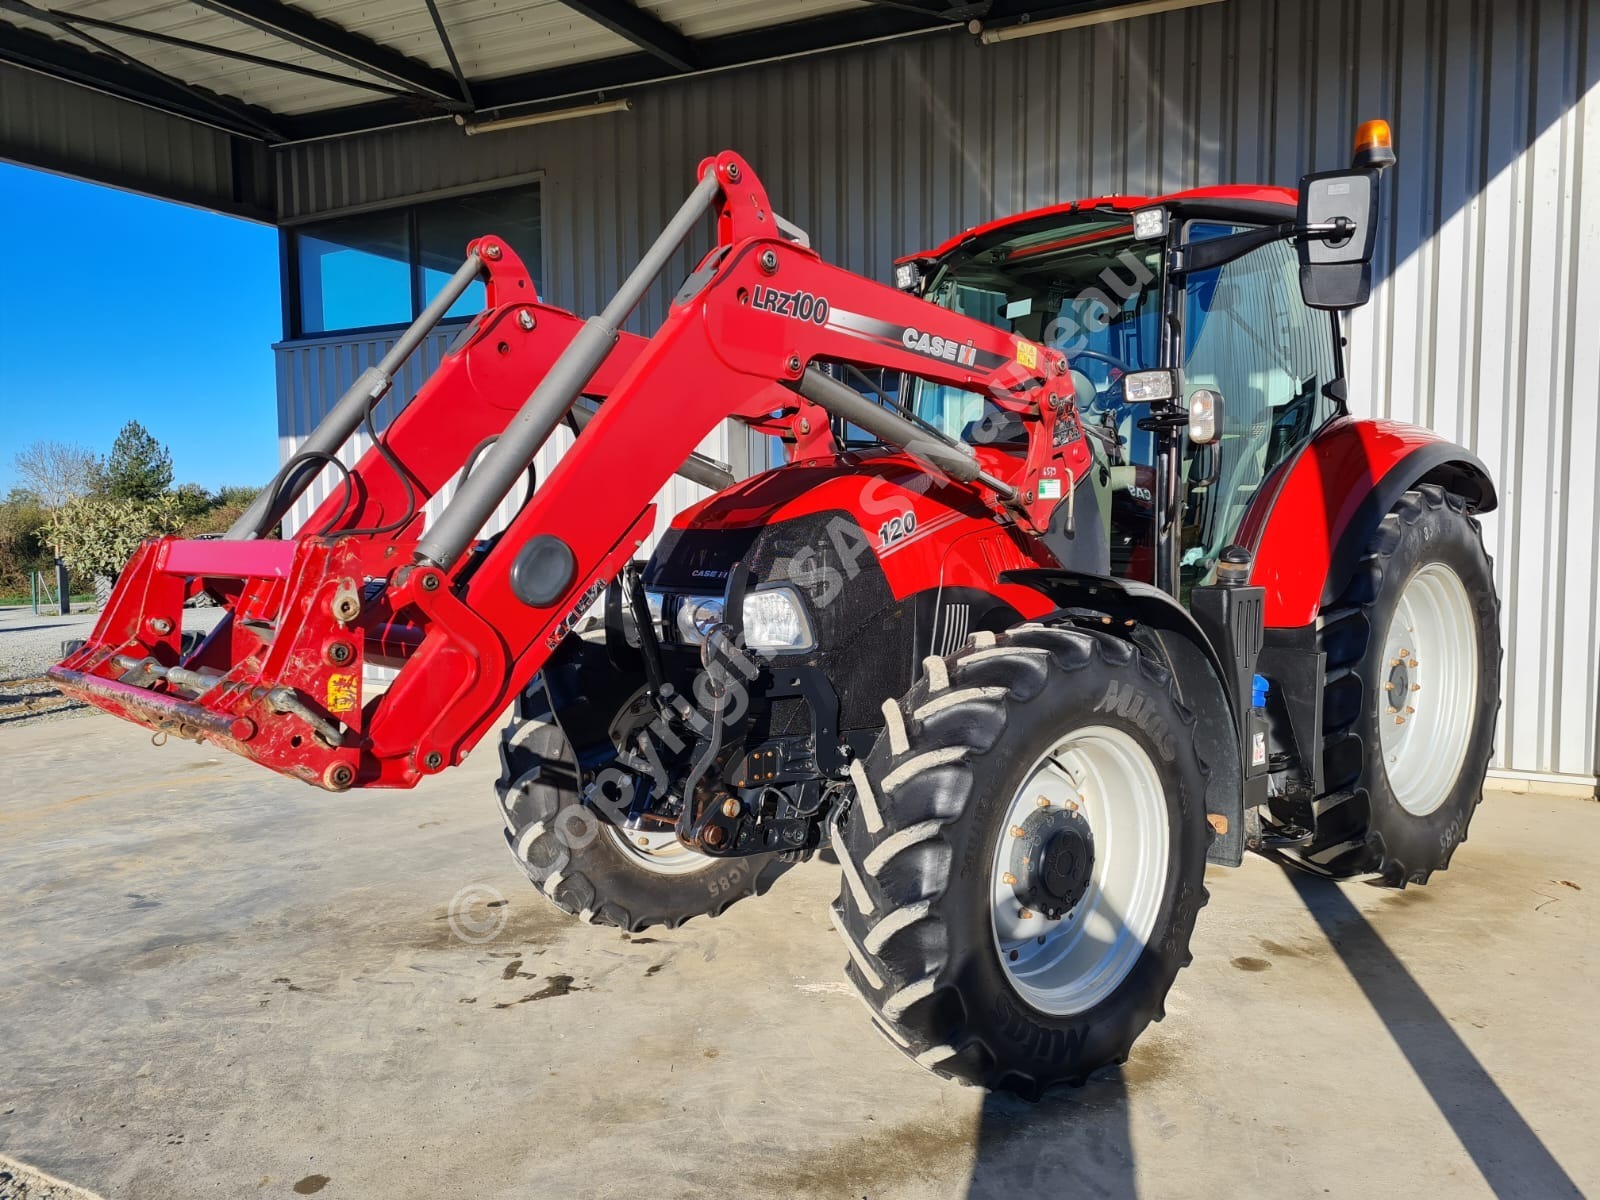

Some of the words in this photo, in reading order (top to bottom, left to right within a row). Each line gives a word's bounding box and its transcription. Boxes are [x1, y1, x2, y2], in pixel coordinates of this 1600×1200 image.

[751, 284, 829, 325] LRZ100
[902, 327, 957, 361] CASE
[878, 511, 918, 547] 120
[691, 569, 718, 578] CASE
[1093, 680, 1176, 762] Mitas
